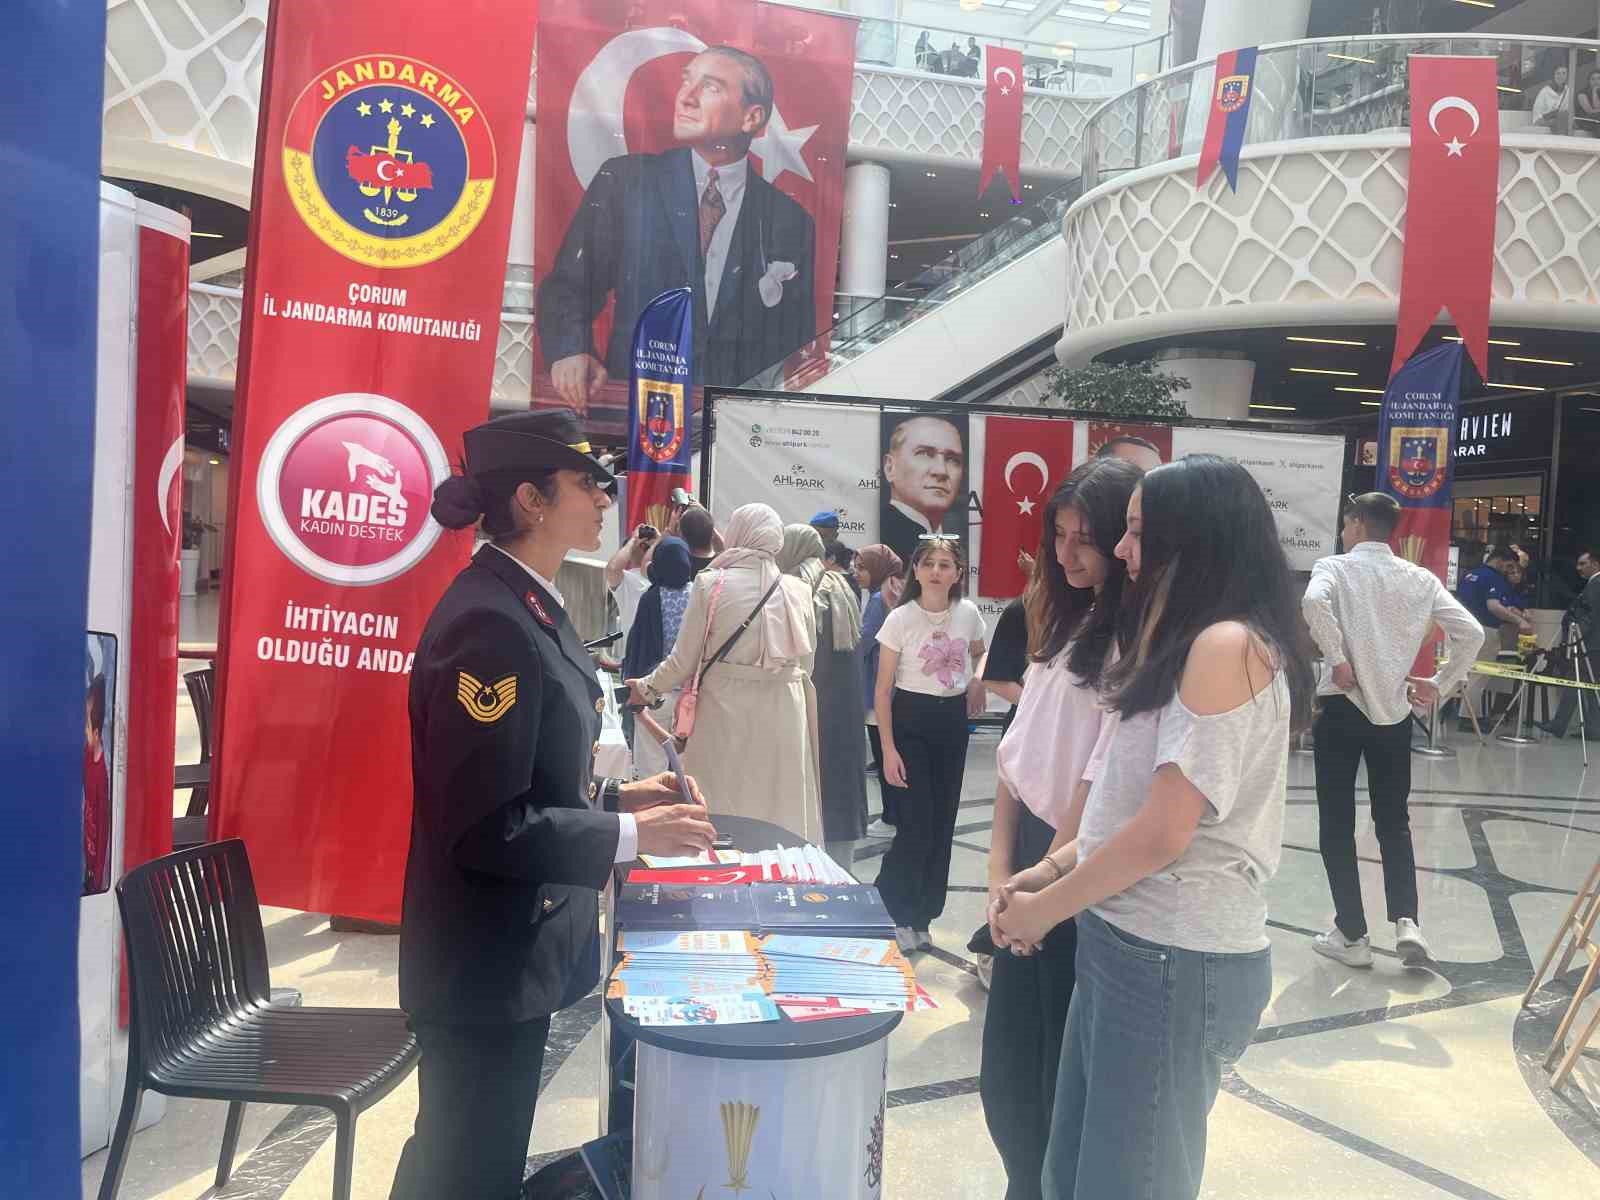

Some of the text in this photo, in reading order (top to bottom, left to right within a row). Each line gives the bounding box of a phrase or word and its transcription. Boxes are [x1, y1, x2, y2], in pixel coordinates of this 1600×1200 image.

[320, 60, 475, 125] JANDARMA
[375, 206, 399, 219] 1839
[348, 282, 407, 307] ÇORUM
[263, 293, 481, 341] İL JANDARMA KOMUTANLIĞI
[300, 487, 408, 528] KADES
[300, 519, 403, 542] KADIN DESTEK
[284, 600, 399, 640] İHTİYACIN
[257, 635, 350, 669] OLDUĞU
